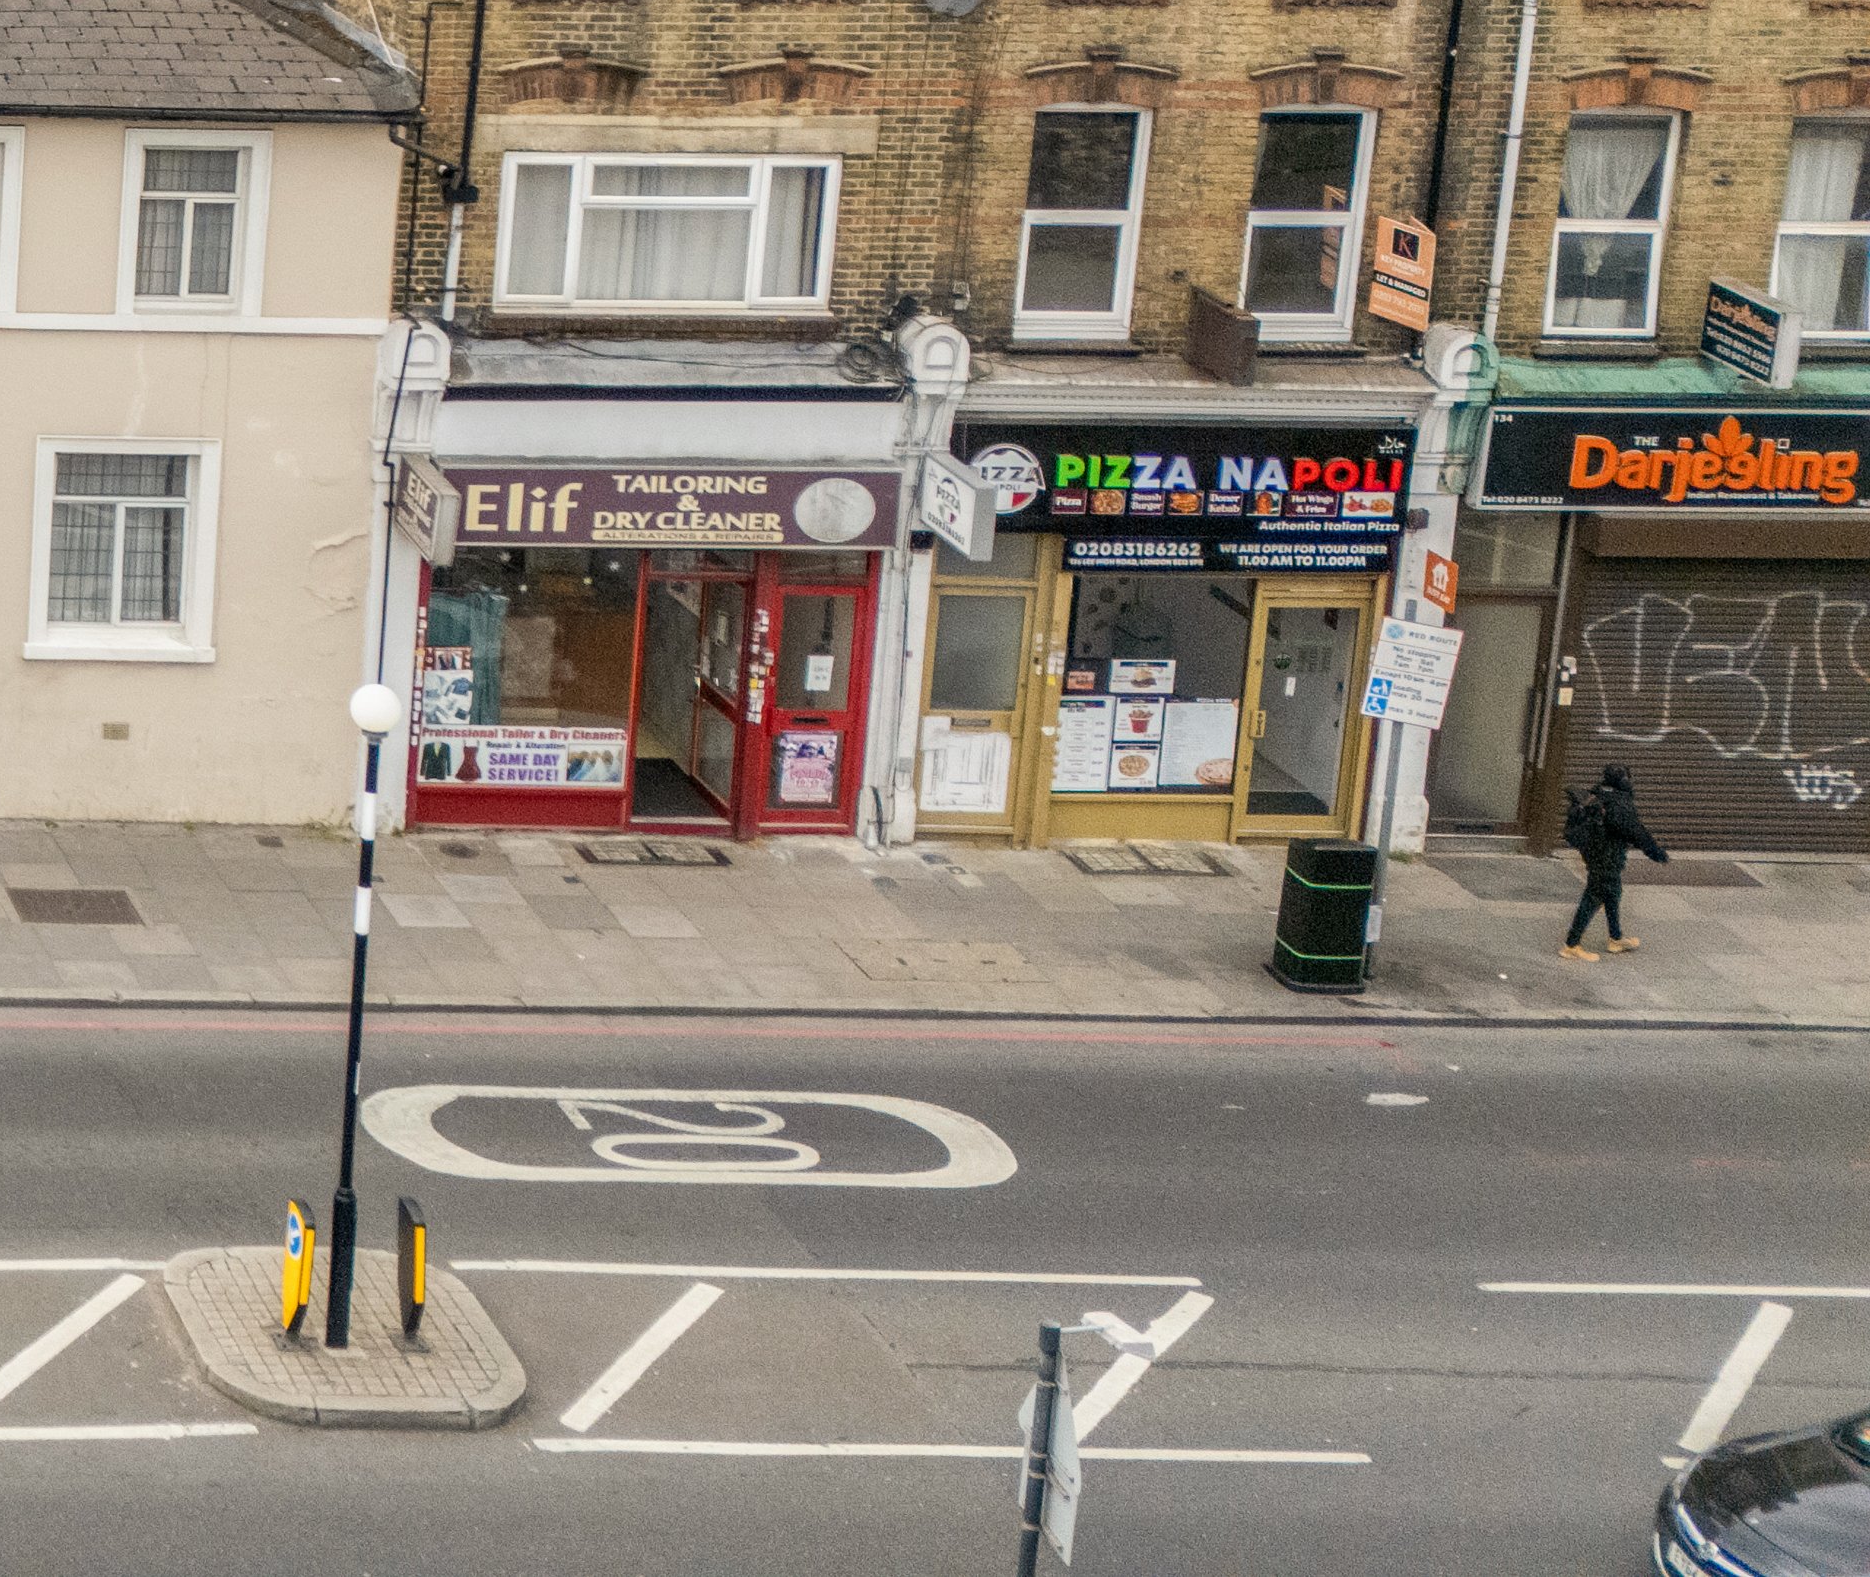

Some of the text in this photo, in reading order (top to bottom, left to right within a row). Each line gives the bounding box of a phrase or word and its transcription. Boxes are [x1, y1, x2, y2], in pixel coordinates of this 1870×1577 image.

[1398, 232, 1415, 261] K
[1376, 273, 1388, 283] LET
[1633, 436, 1661, 447] THE
[1056, 454, 1404, 492] PIZZA NAPOLI
[1570, 434, 1859, 504] Darjeeling
[981, 465, 1044, 488] IZZA
[407, 470, 433, 512] Elif
[612, 475, 768, 495] TAILORING
[677, 495, 701, 512] &
[1055, 496, 1082, 507] Pizza
[1210, 493, 1241, 502] Doner
[1291, 495, 1309, 503] Hot
[464, 482, 583, 533] Elif
[594, 511, 782, 531] DRY CLEANER
[1259, 521, 1400, 532] Authentic Italian Pizza
[603, 531, 697, 540] ALTERATIONS
[715, 533, 774, 541] REPAIRS
[1074, 542, 1202, 557] 02083186262
[1219, 543, 1388, 554] WE ARE OPEN FOR YOUR ORDER
[1237, 555, 1366, 567] 11.00 AM TO 11.00PM
[1409, 631, 1458, 647] RED ROUTE
[1393, 646, 1441, 661] No stopping
[1375, 669, 1402, 681] Except
[422, 727, 627, 741] Professional Tailor & Dry Cleaners
[486, 741, 512, 750] Repair
[489, 753, 560, 767] SAME DAY
[488, 768, 559, 782] SERVICE!
[556, 1099, 821, 1172] 20
